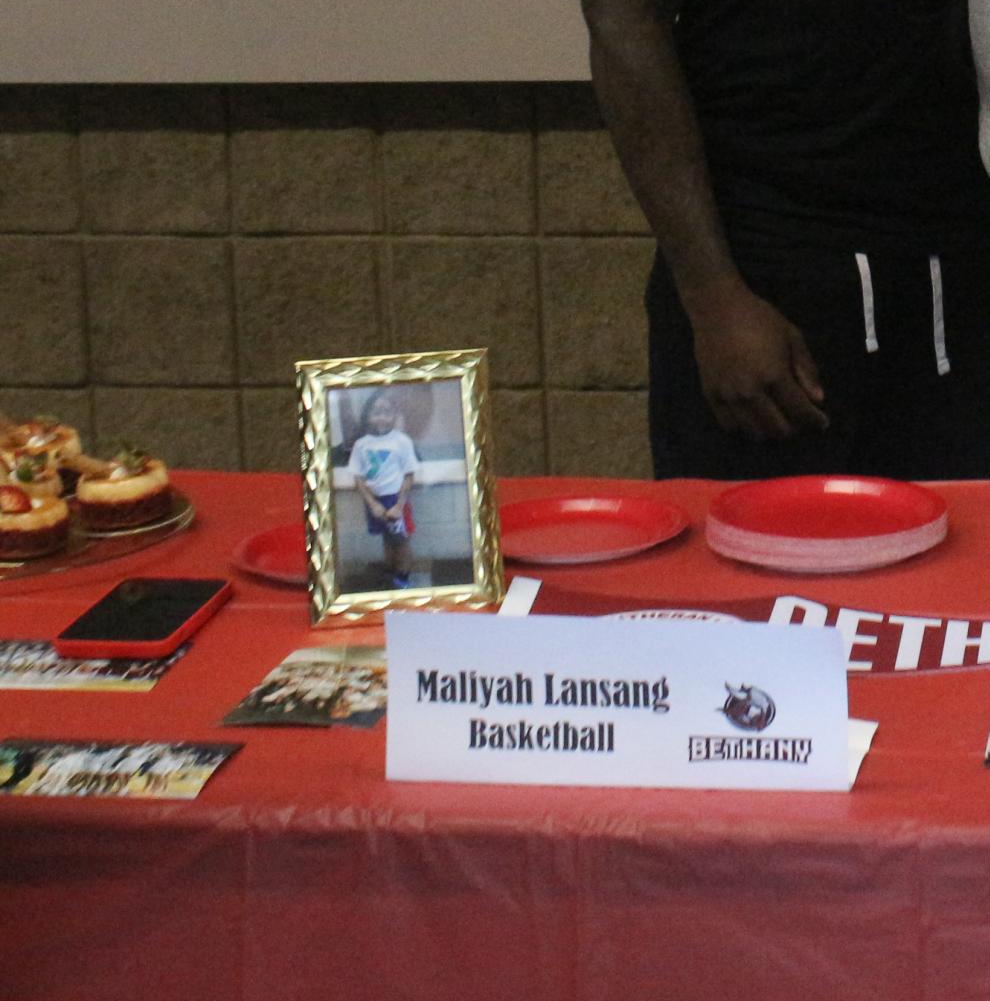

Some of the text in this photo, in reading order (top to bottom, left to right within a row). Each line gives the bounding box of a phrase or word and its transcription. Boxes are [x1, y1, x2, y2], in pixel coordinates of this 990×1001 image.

[416, 669, 671, 713] Maliyah Lansang
[467, 719, 615, 753] Basketball
[687, 735, 813, 764] BETHANY
